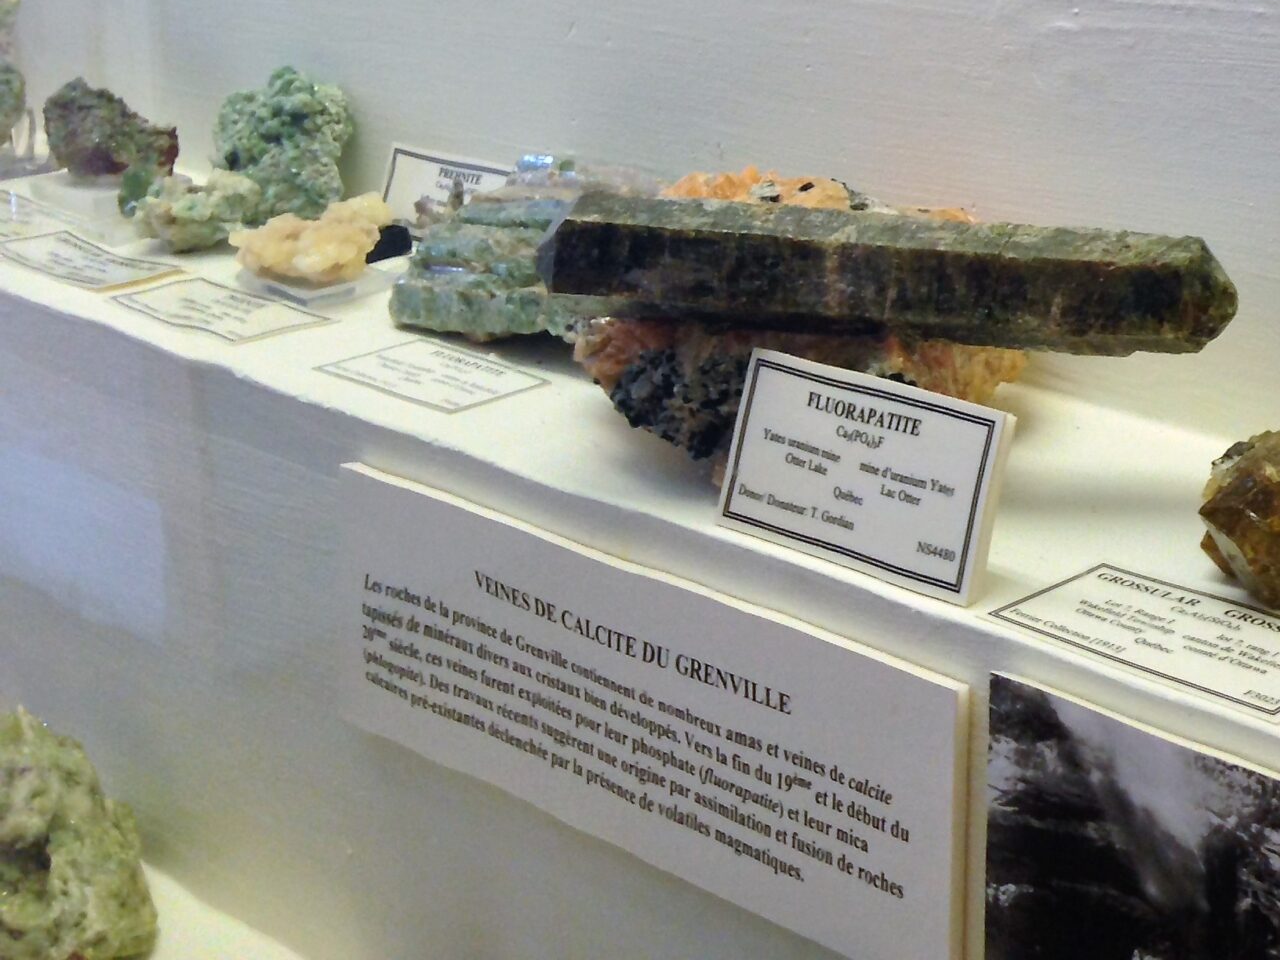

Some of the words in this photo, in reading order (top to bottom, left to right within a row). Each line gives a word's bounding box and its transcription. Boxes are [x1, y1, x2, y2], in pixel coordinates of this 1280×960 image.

[807, 391, 922, 436] FLUORAPATITE
[916, 541, 955, 562] NS4480
[1096, 570, 1200, 607] GROSSULAR
[474, 570, 530, 611] VEINES
[534, 598, 557, 623] DE
[561, 609, 636, 658] CALCITE
[642, 641, 669, 668] DU
[676, 653, 792, 715] GRENVILLE
[658, 698, 721, 738] nombreux
[726, 729, 762, 752] amas
[767, 742, 780, 759] et
[784, 749, 825, 778] veines
[830, 762, 845, 785] de
[849, 775, 893, 806] calcite
[622, 758, 666, 788] origine
[670, 779, 690, 799] par
[695, 791, 771, 839] assimilation
[775, 825, 788, 843] et
[792, 831, 833, 866] fusion
[838, 853, 854, 875] de
[858, 867, 904, 899] roches
